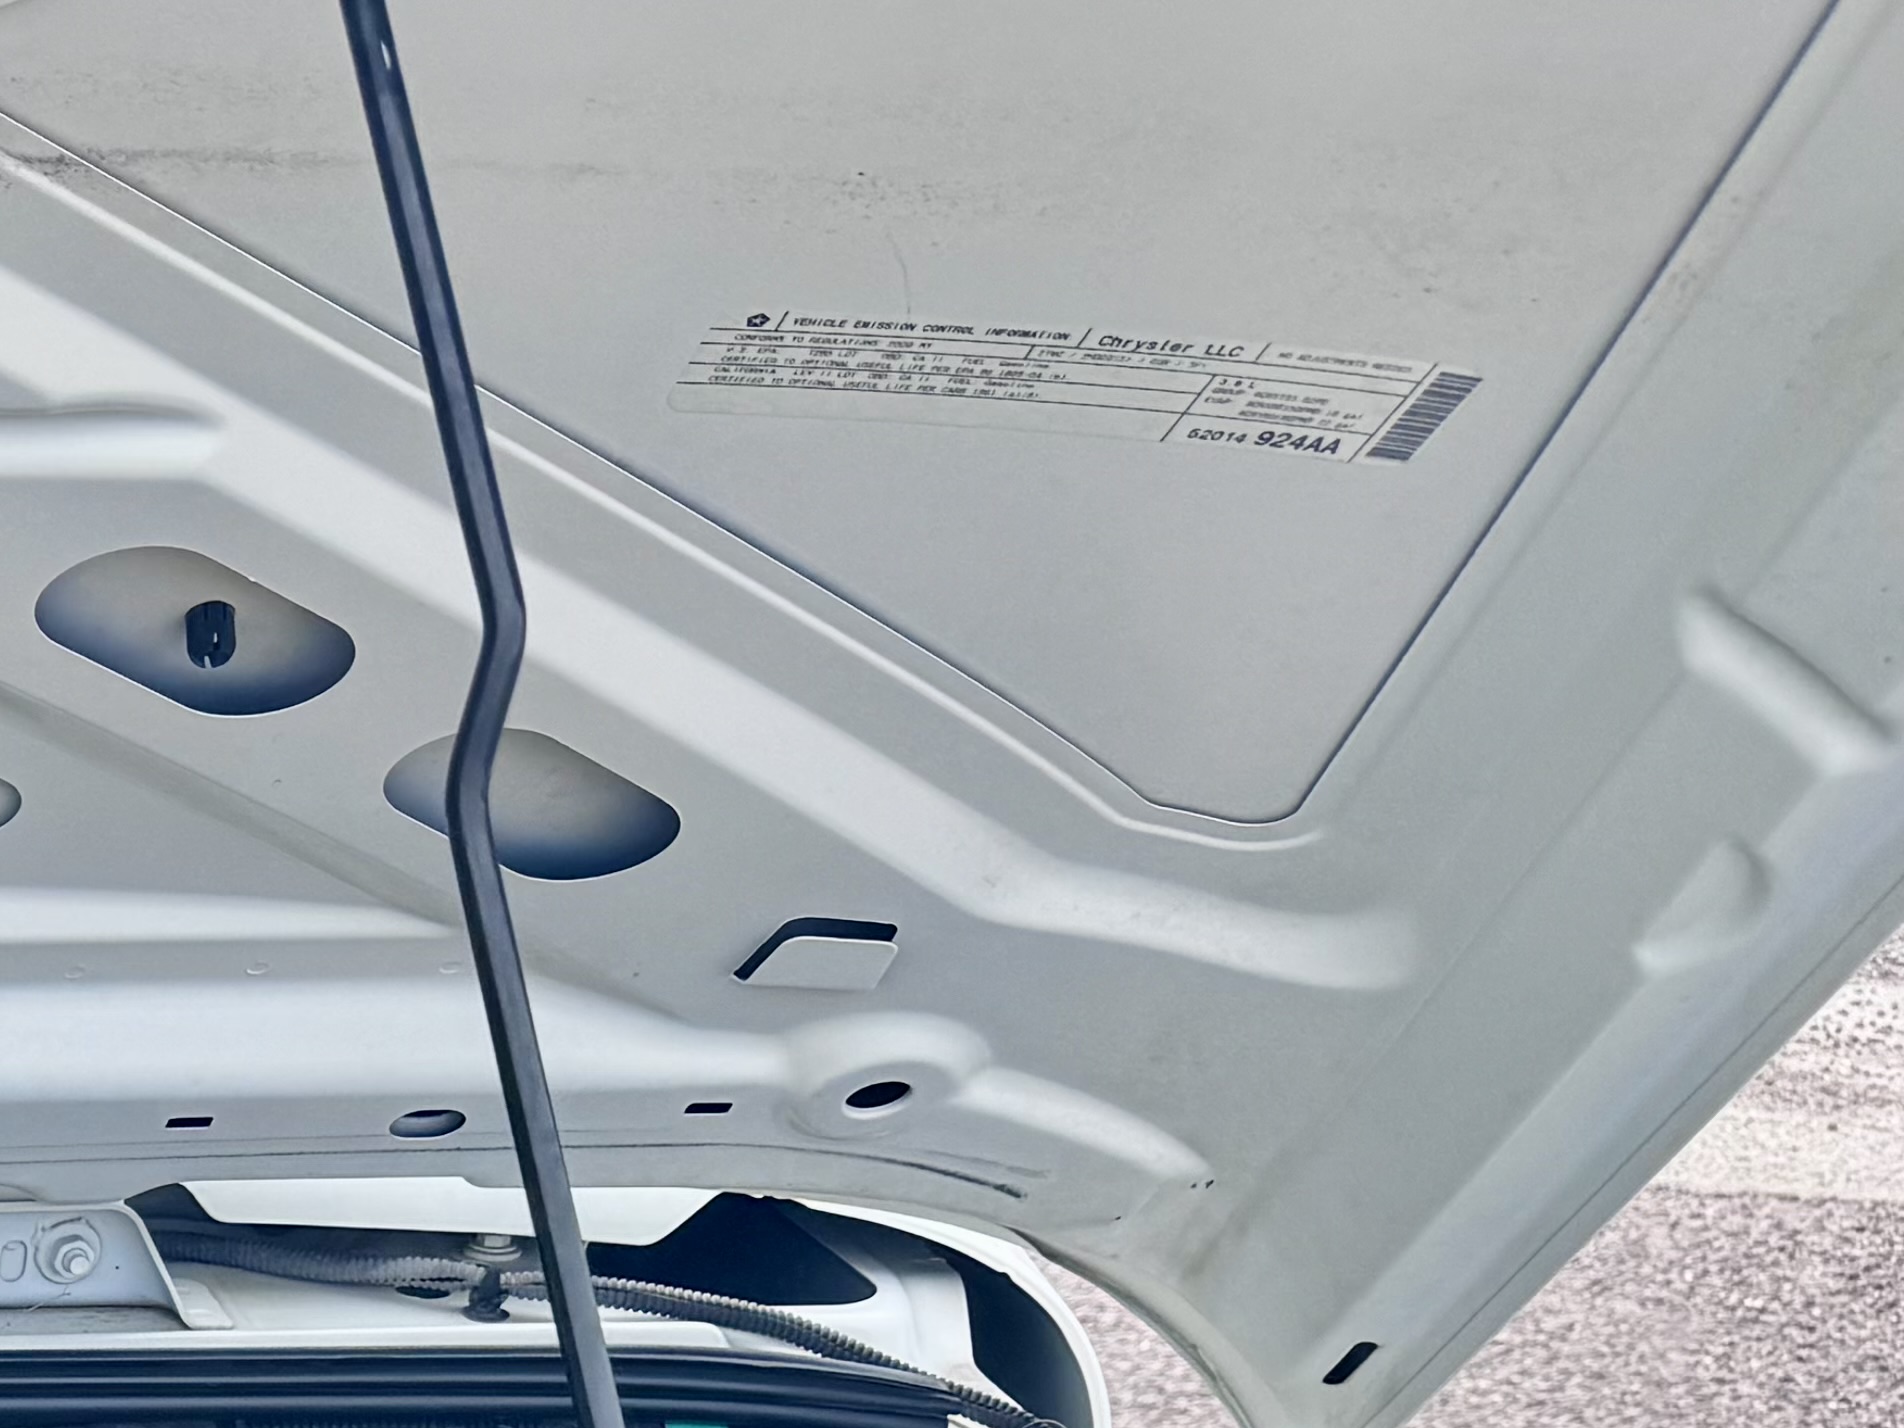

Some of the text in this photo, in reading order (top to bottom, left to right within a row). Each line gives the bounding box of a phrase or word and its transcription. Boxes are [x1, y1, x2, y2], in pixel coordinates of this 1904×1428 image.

[793, 317, 1071, 341] VEHICLE EMISSION CONTROL INFORMATION
[1097, 334, 1245, 358] Chrysler LLC
[1253, 429, 1342, 455] 924AA
